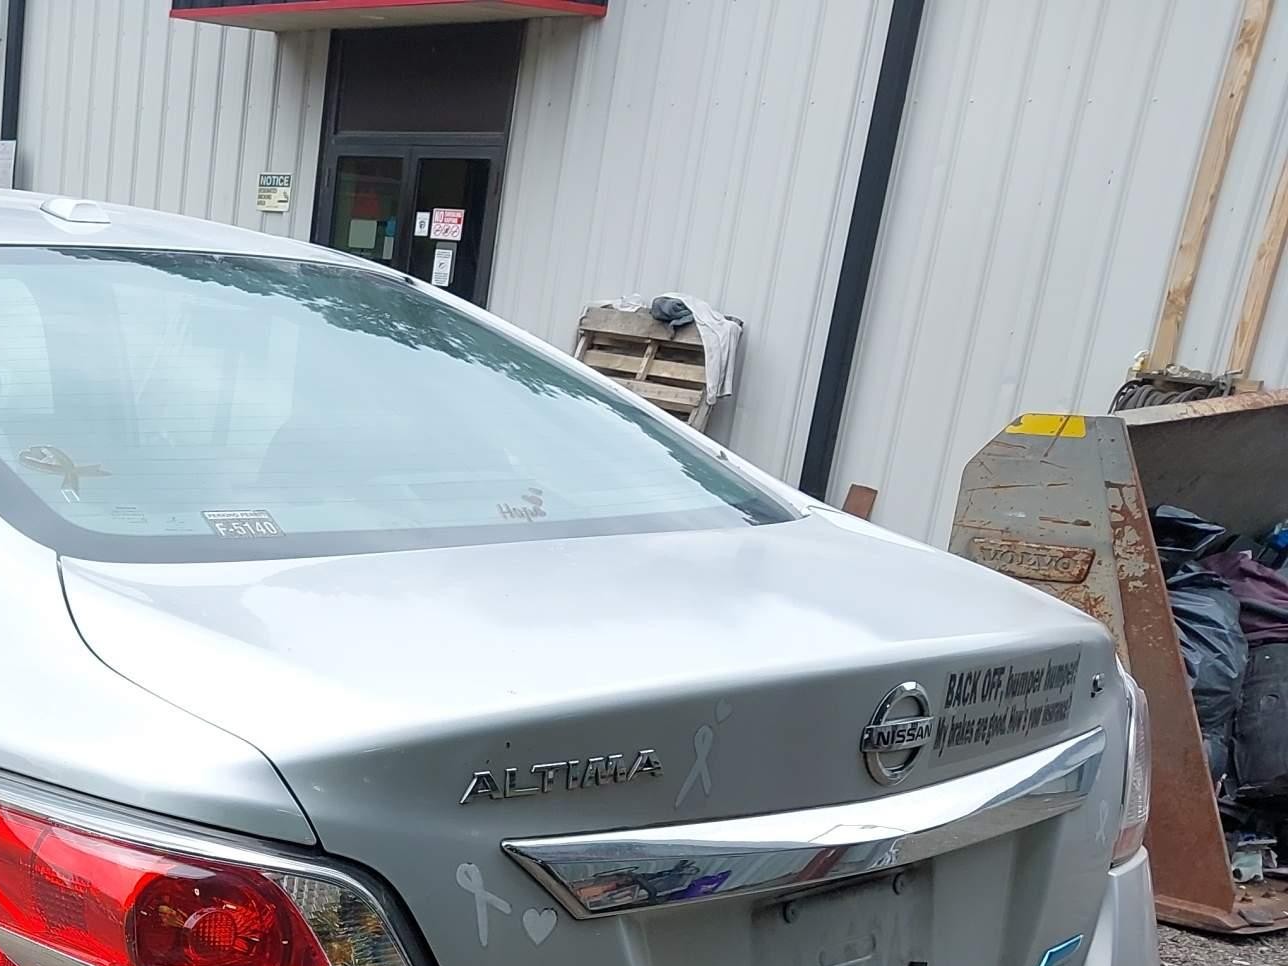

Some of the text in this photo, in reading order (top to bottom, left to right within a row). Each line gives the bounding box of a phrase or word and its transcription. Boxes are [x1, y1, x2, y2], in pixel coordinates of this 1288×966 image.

[260, 175, 290, 186] NOTICE
[215, 521, 278, 537] F-5140
[979, 547, 1073, 574] VOLVO
[944, 670, 982, 709] BACK
[980, 666, 1006, 707] OFF,
[1004, 665, 1046, 709] bumper
[875, 721, 933, 747] NISSAN
[459, 749, 663, 805] ALTIMA
